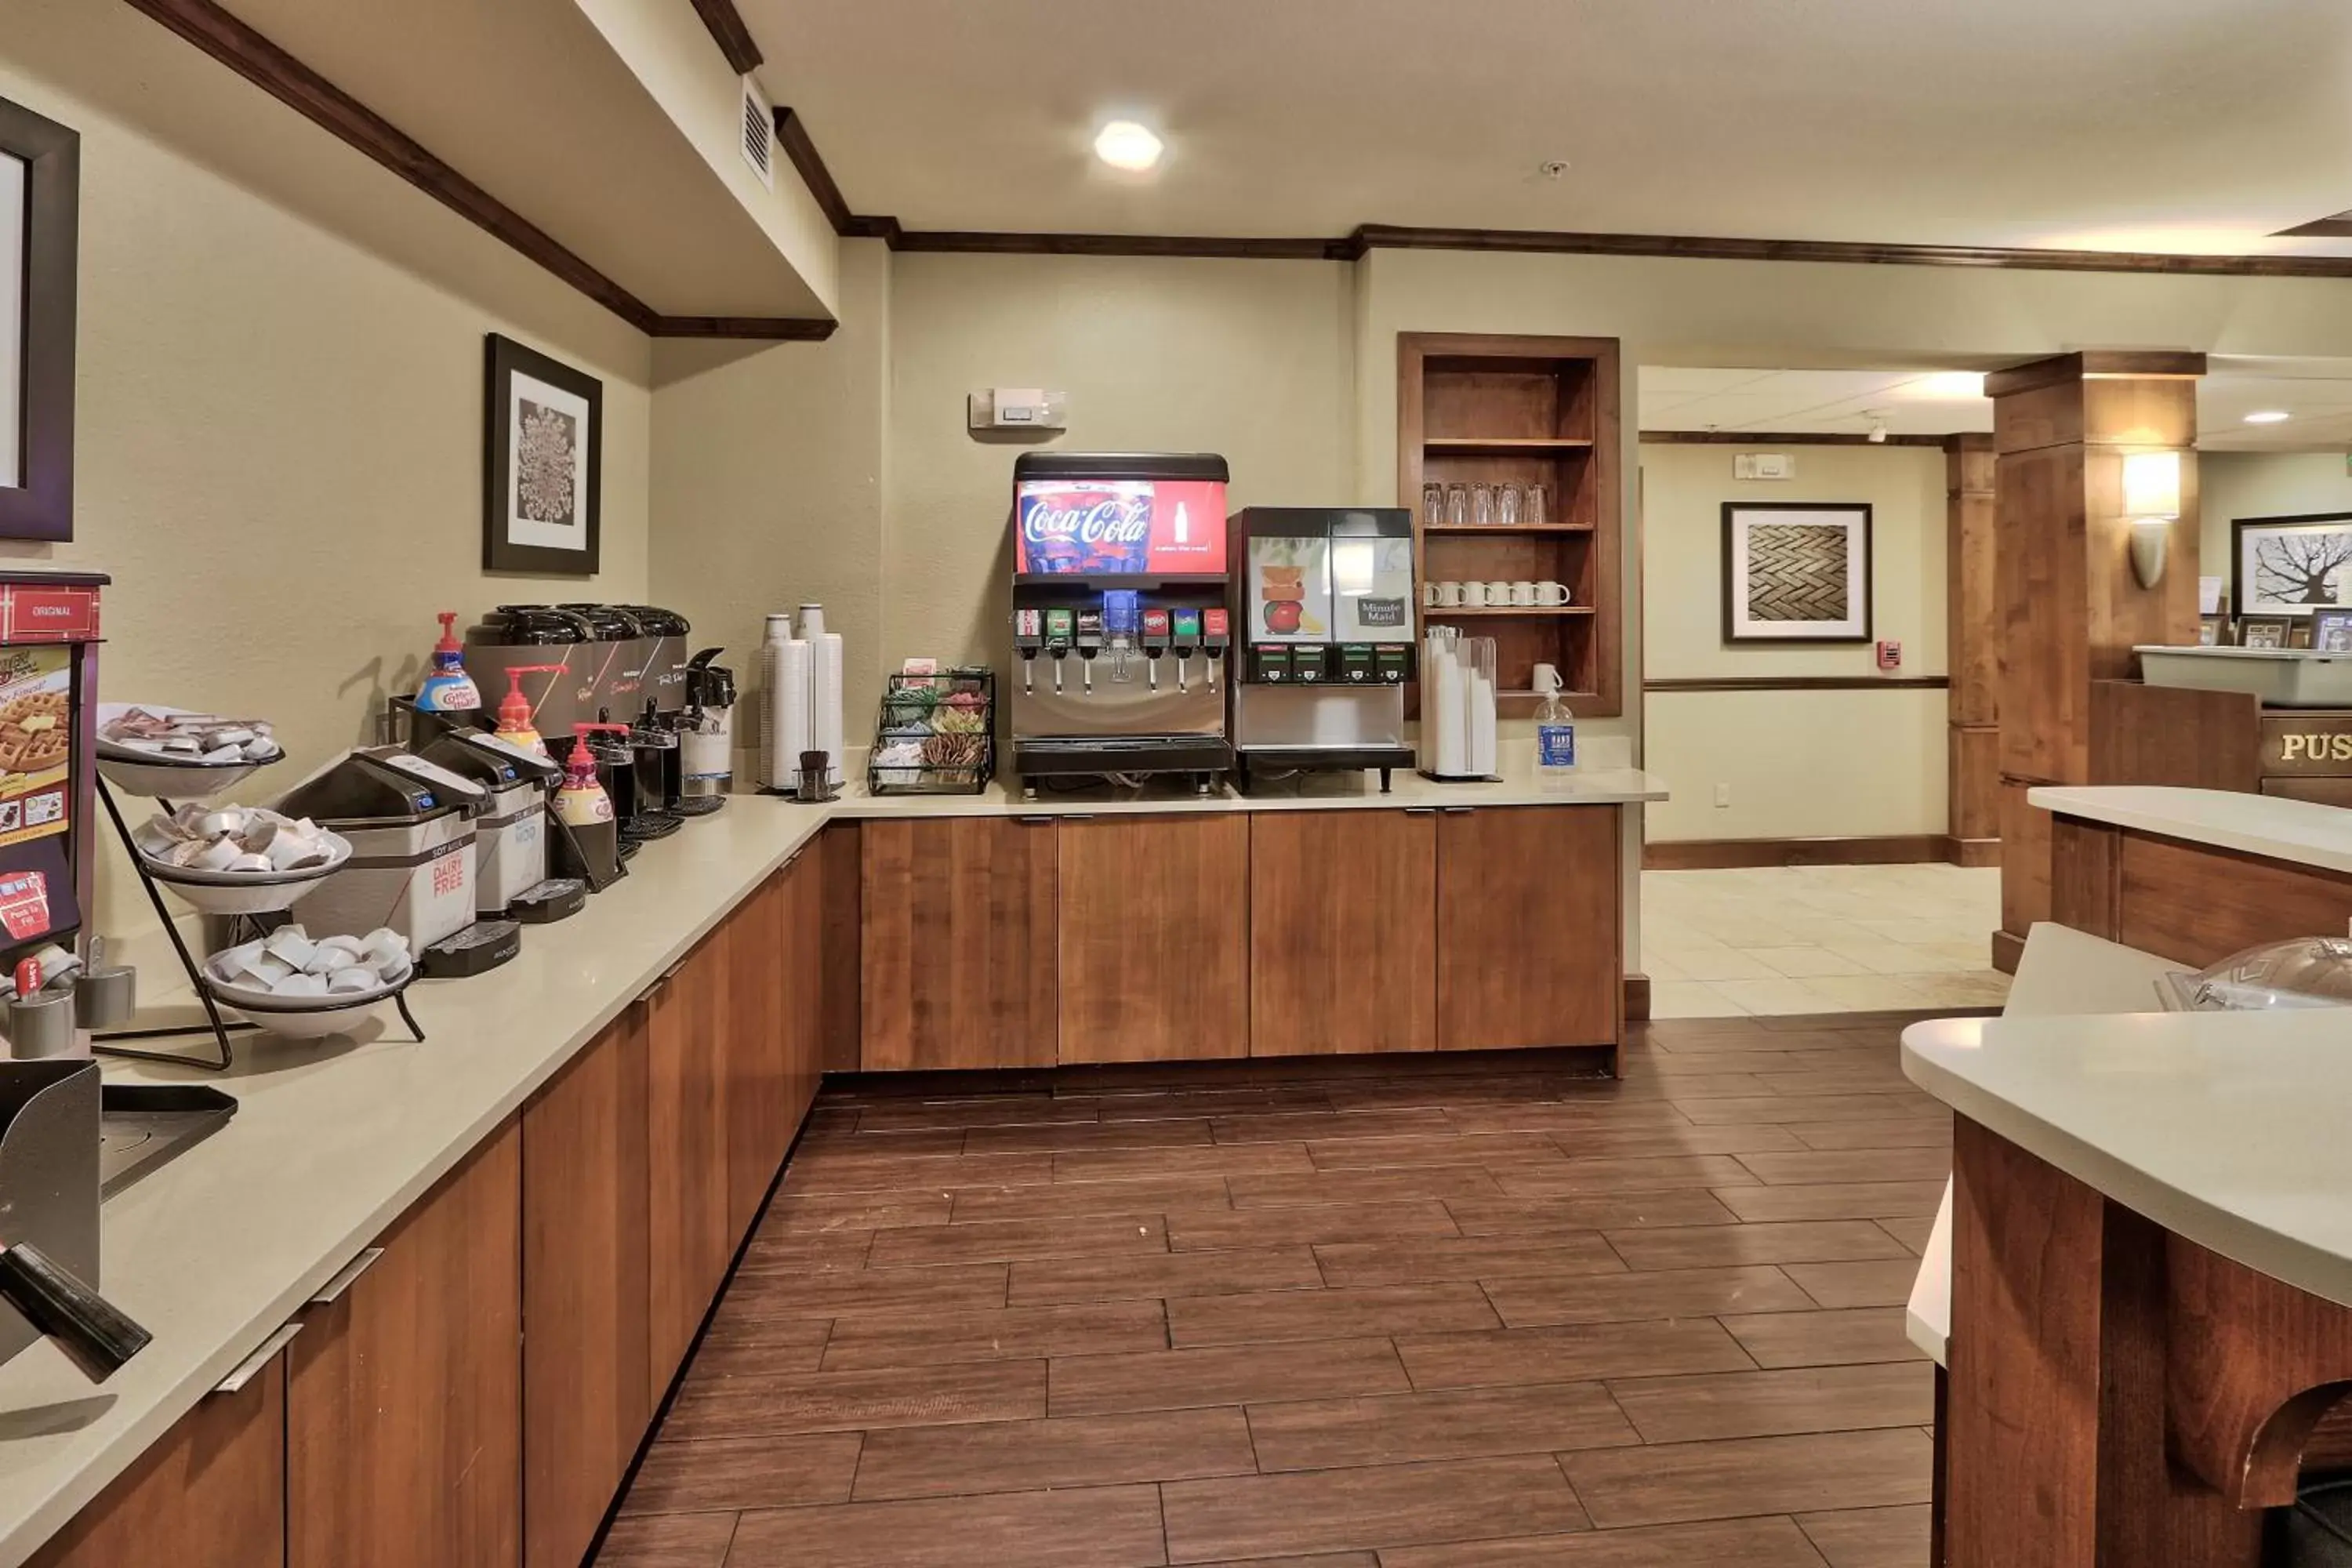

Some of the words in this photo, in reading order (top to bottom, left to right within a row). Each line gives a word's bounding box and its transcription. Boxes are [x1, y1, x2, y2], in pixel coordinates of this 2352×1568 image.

[1025, 500, 1149, 543] Coca-Cola
[32, 606, 71, 616] ORIGINAL
[1363, 602, 1401, 612] Minute
[1368, 612, 1395, 622] Maid
[2281, 734, 2352, 760] PUS
[434, 871, 463, 898] FREE
